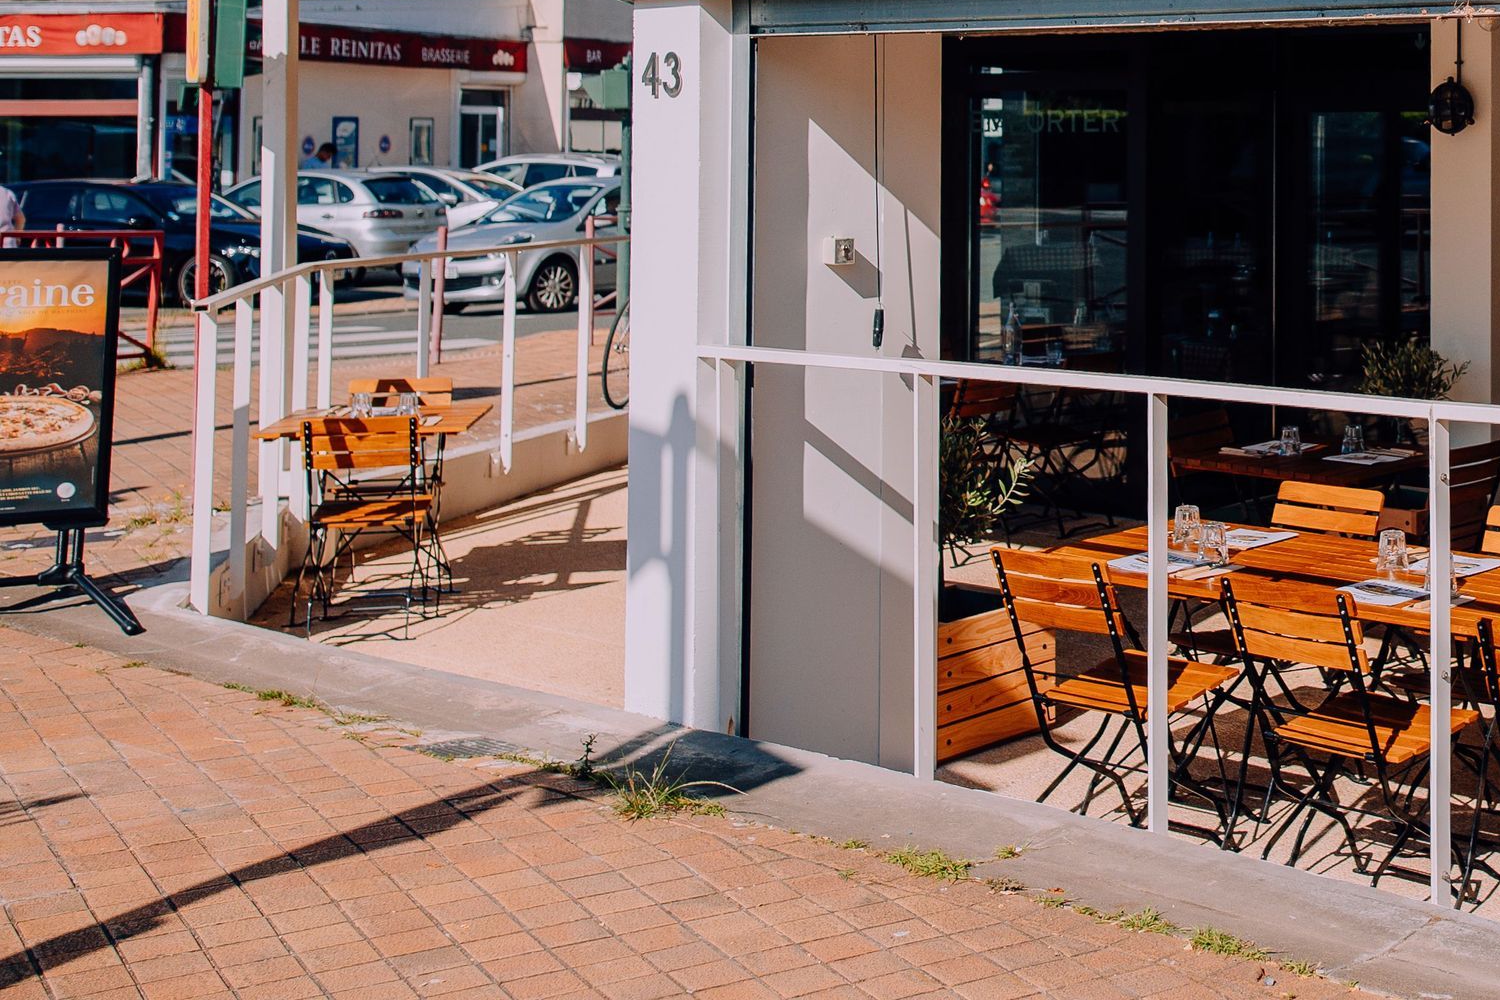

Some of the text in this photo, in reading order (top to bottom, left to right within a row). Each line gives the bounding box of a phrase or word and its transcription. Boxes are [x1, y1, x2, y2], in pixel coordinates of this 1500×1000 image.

[300, 34, 471, 65] LE REINITAS BRASSERIE
[586, 48, 602, 64] BAR
[641, 51, 683, 99] 43
[0, 278, 95, 308] aine
